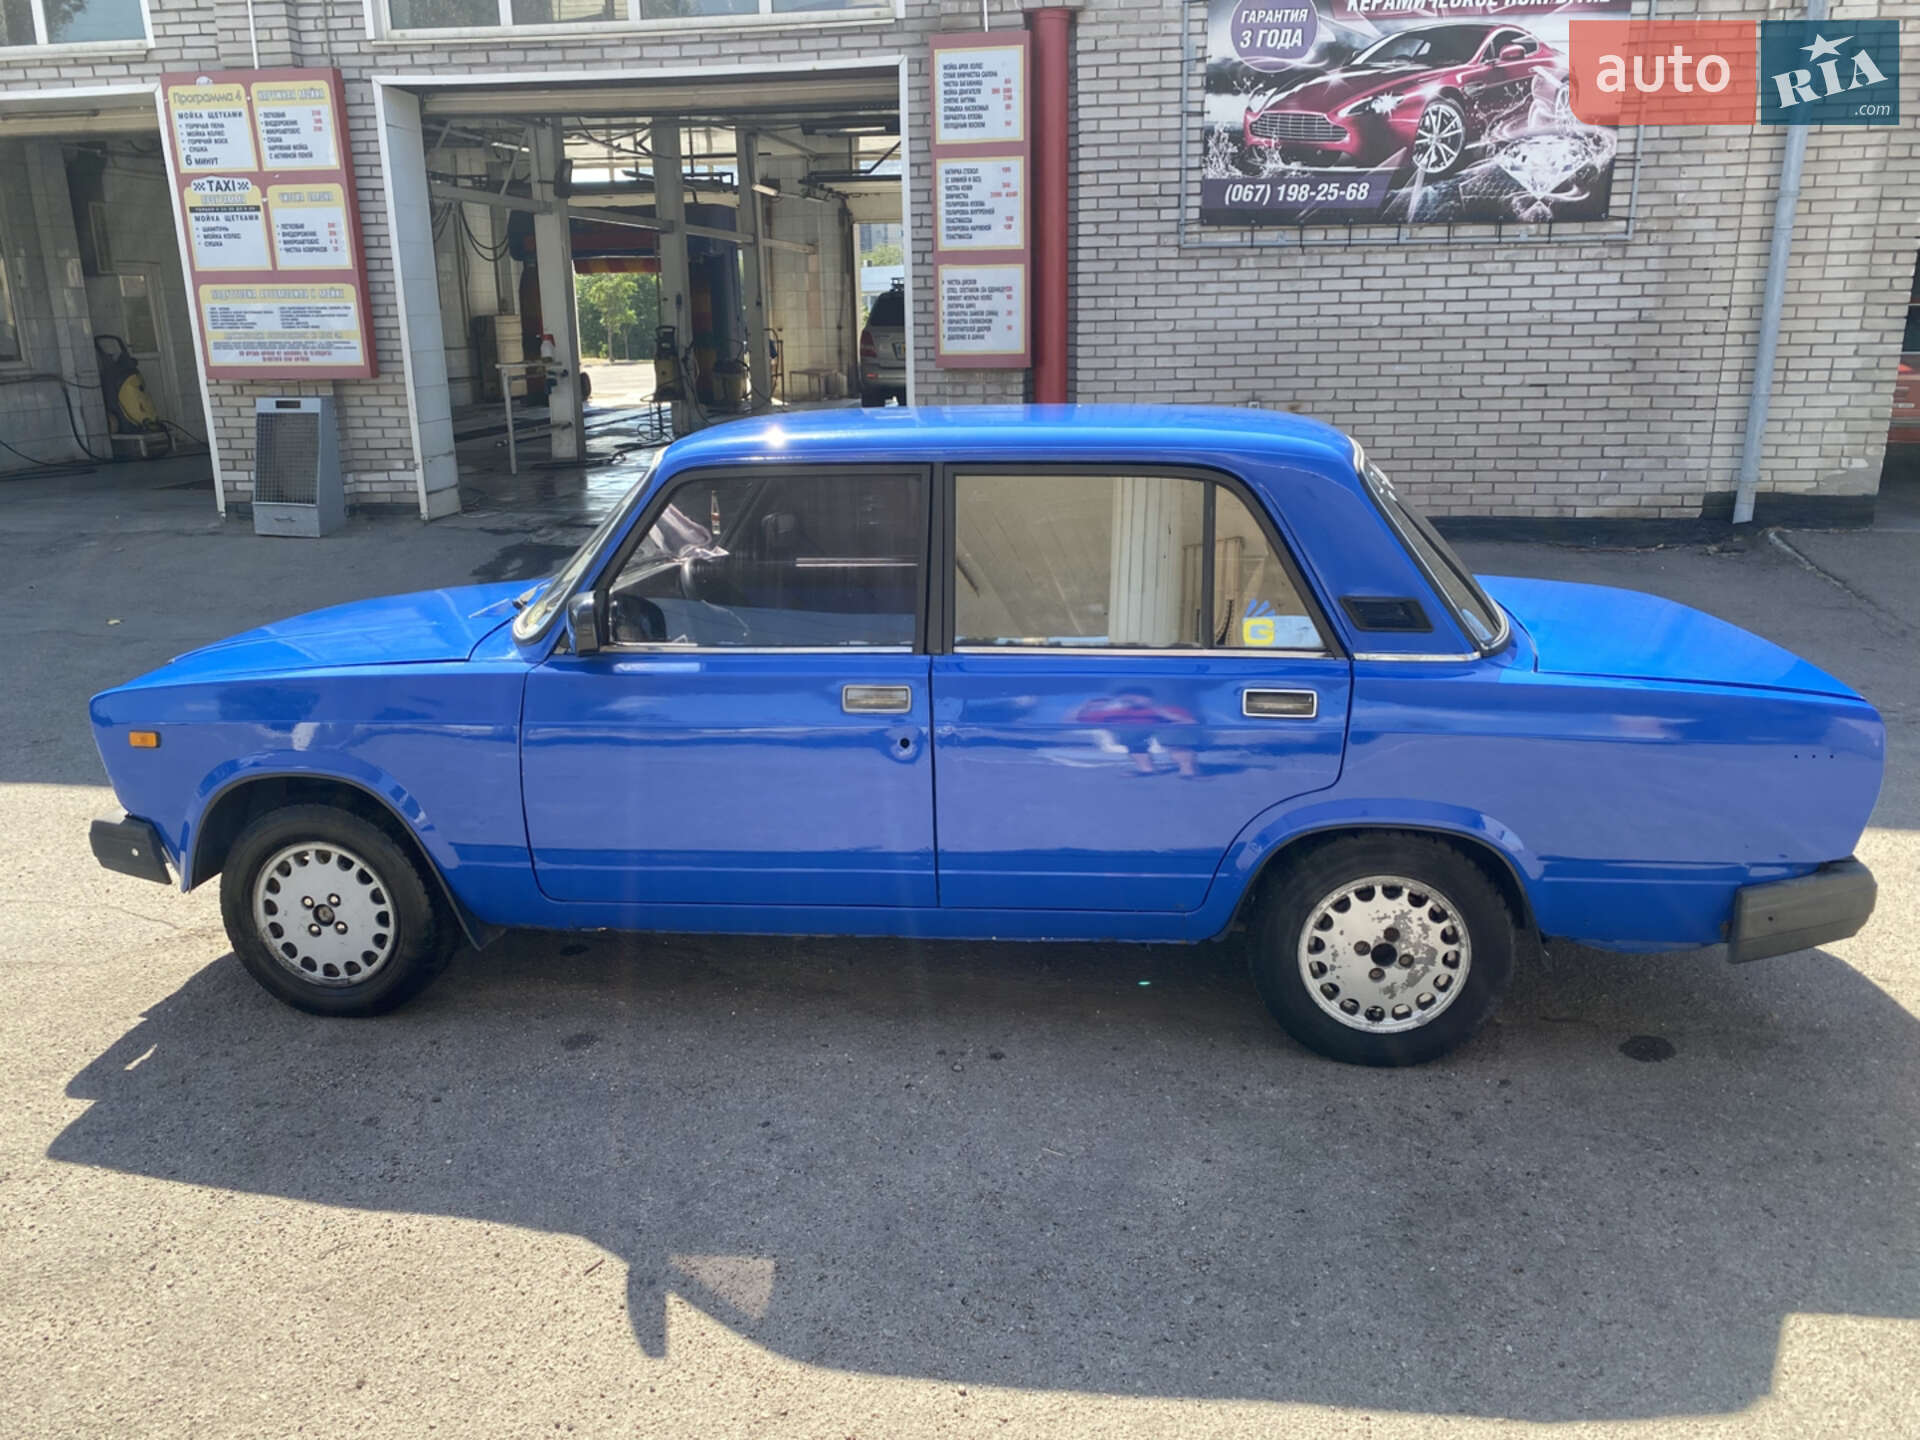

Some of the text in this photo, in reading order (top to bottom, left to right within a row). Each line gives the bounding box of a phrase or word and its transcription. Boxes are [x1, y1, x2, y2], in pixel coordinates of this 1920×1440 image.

[1241, 8, 1309, 24] ГАРАНТИЯ
[1240, 28, 1303, 50] 3 ГОДА
[178, 111, 203, 119] МОЙКА
[194, 157, 218, 165] МИНУТ
[206, 180, 236, 192] TAXI
[1225, 183, 1370, 206] (067) 198-25-68
